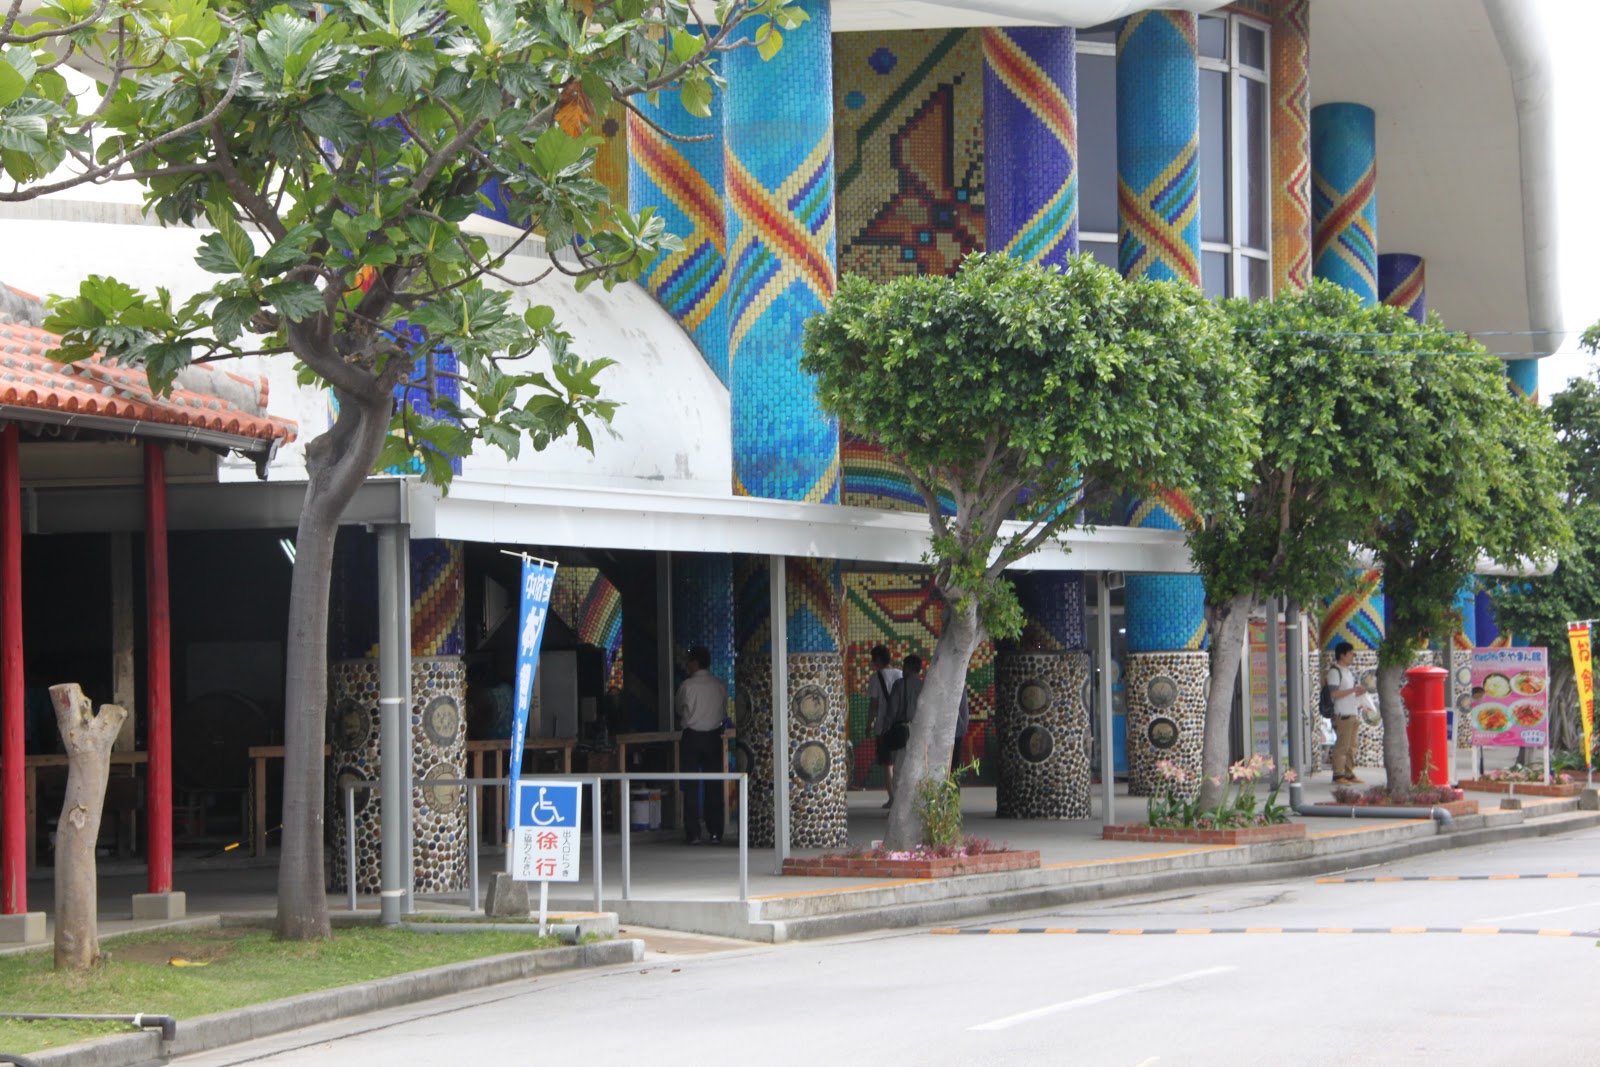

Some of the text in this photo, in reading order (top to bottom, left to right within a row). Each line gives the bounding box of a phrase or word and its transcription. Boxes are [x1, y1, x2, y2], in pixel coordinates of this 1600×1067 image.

[535, 831, 559, 877] 徐行
[562, 830, 571, 877] 出入口につき
